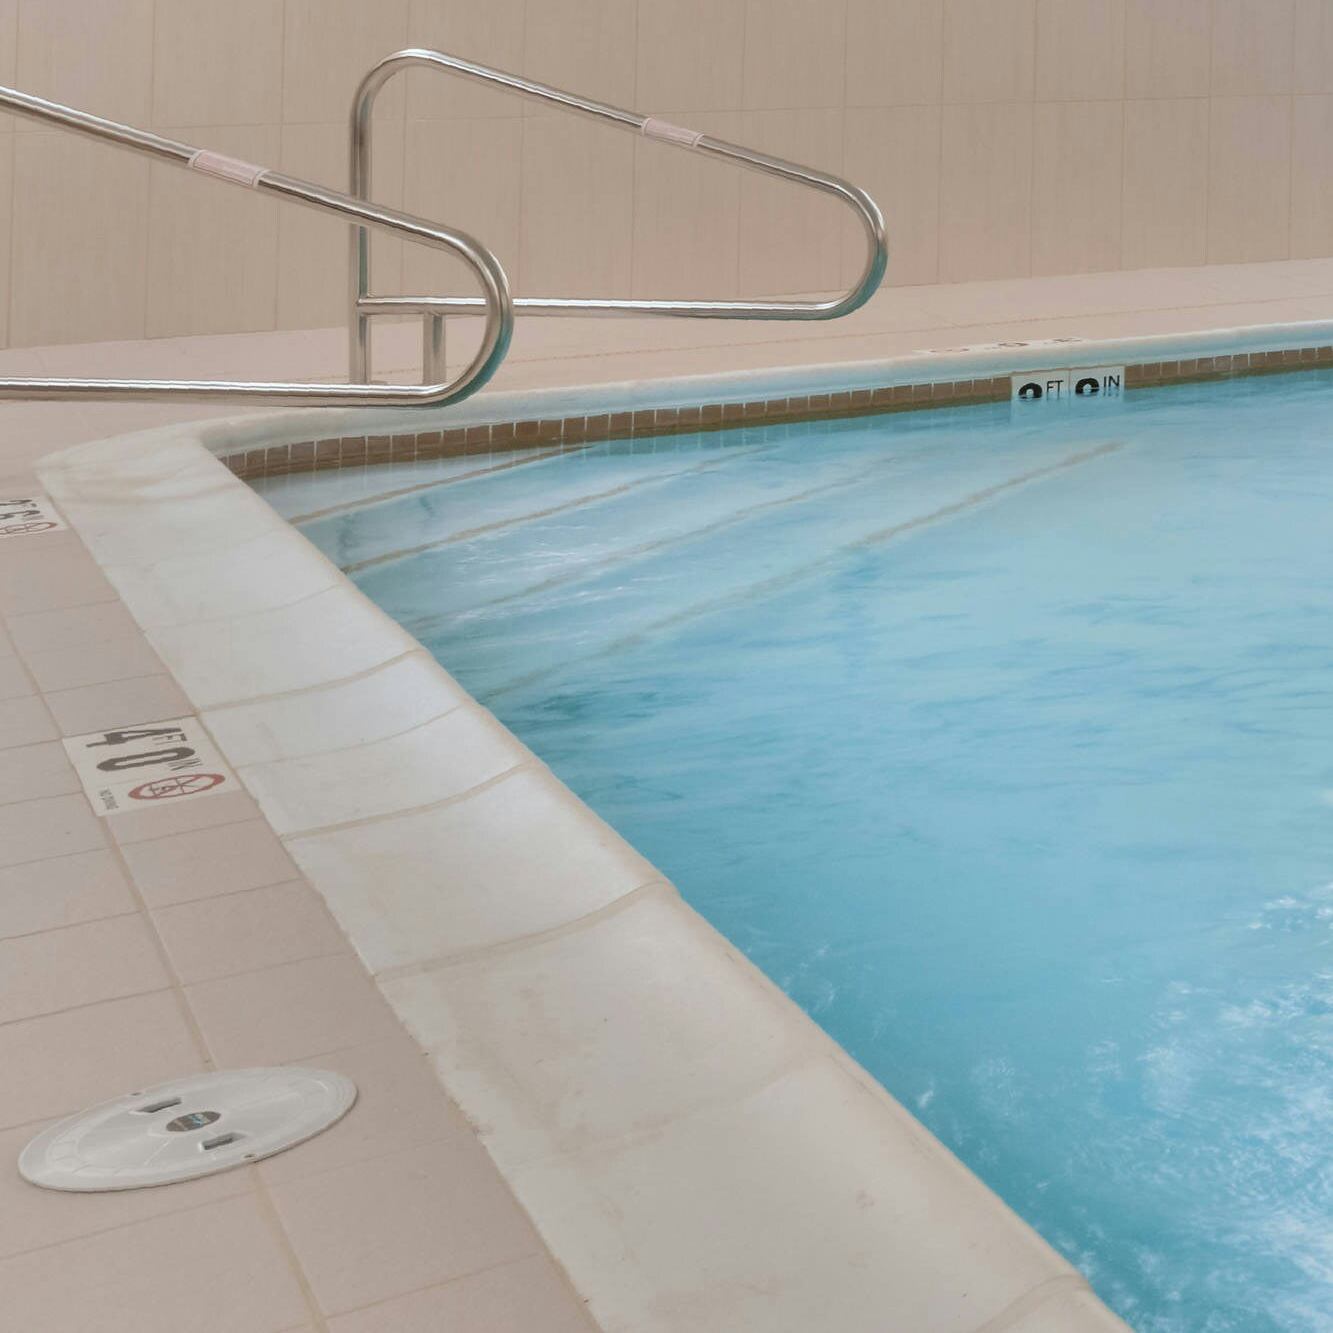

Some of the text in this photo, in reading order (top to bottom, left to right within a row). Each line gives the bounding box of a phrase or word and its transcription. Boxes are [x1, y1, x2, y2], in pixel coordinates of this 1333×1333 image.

[1047, 380, 1064, 393] FT
[1104, 375, 1120, 388] IN
[86, 727, 182, 748] 4
[96, 746, 196, 772] 0
